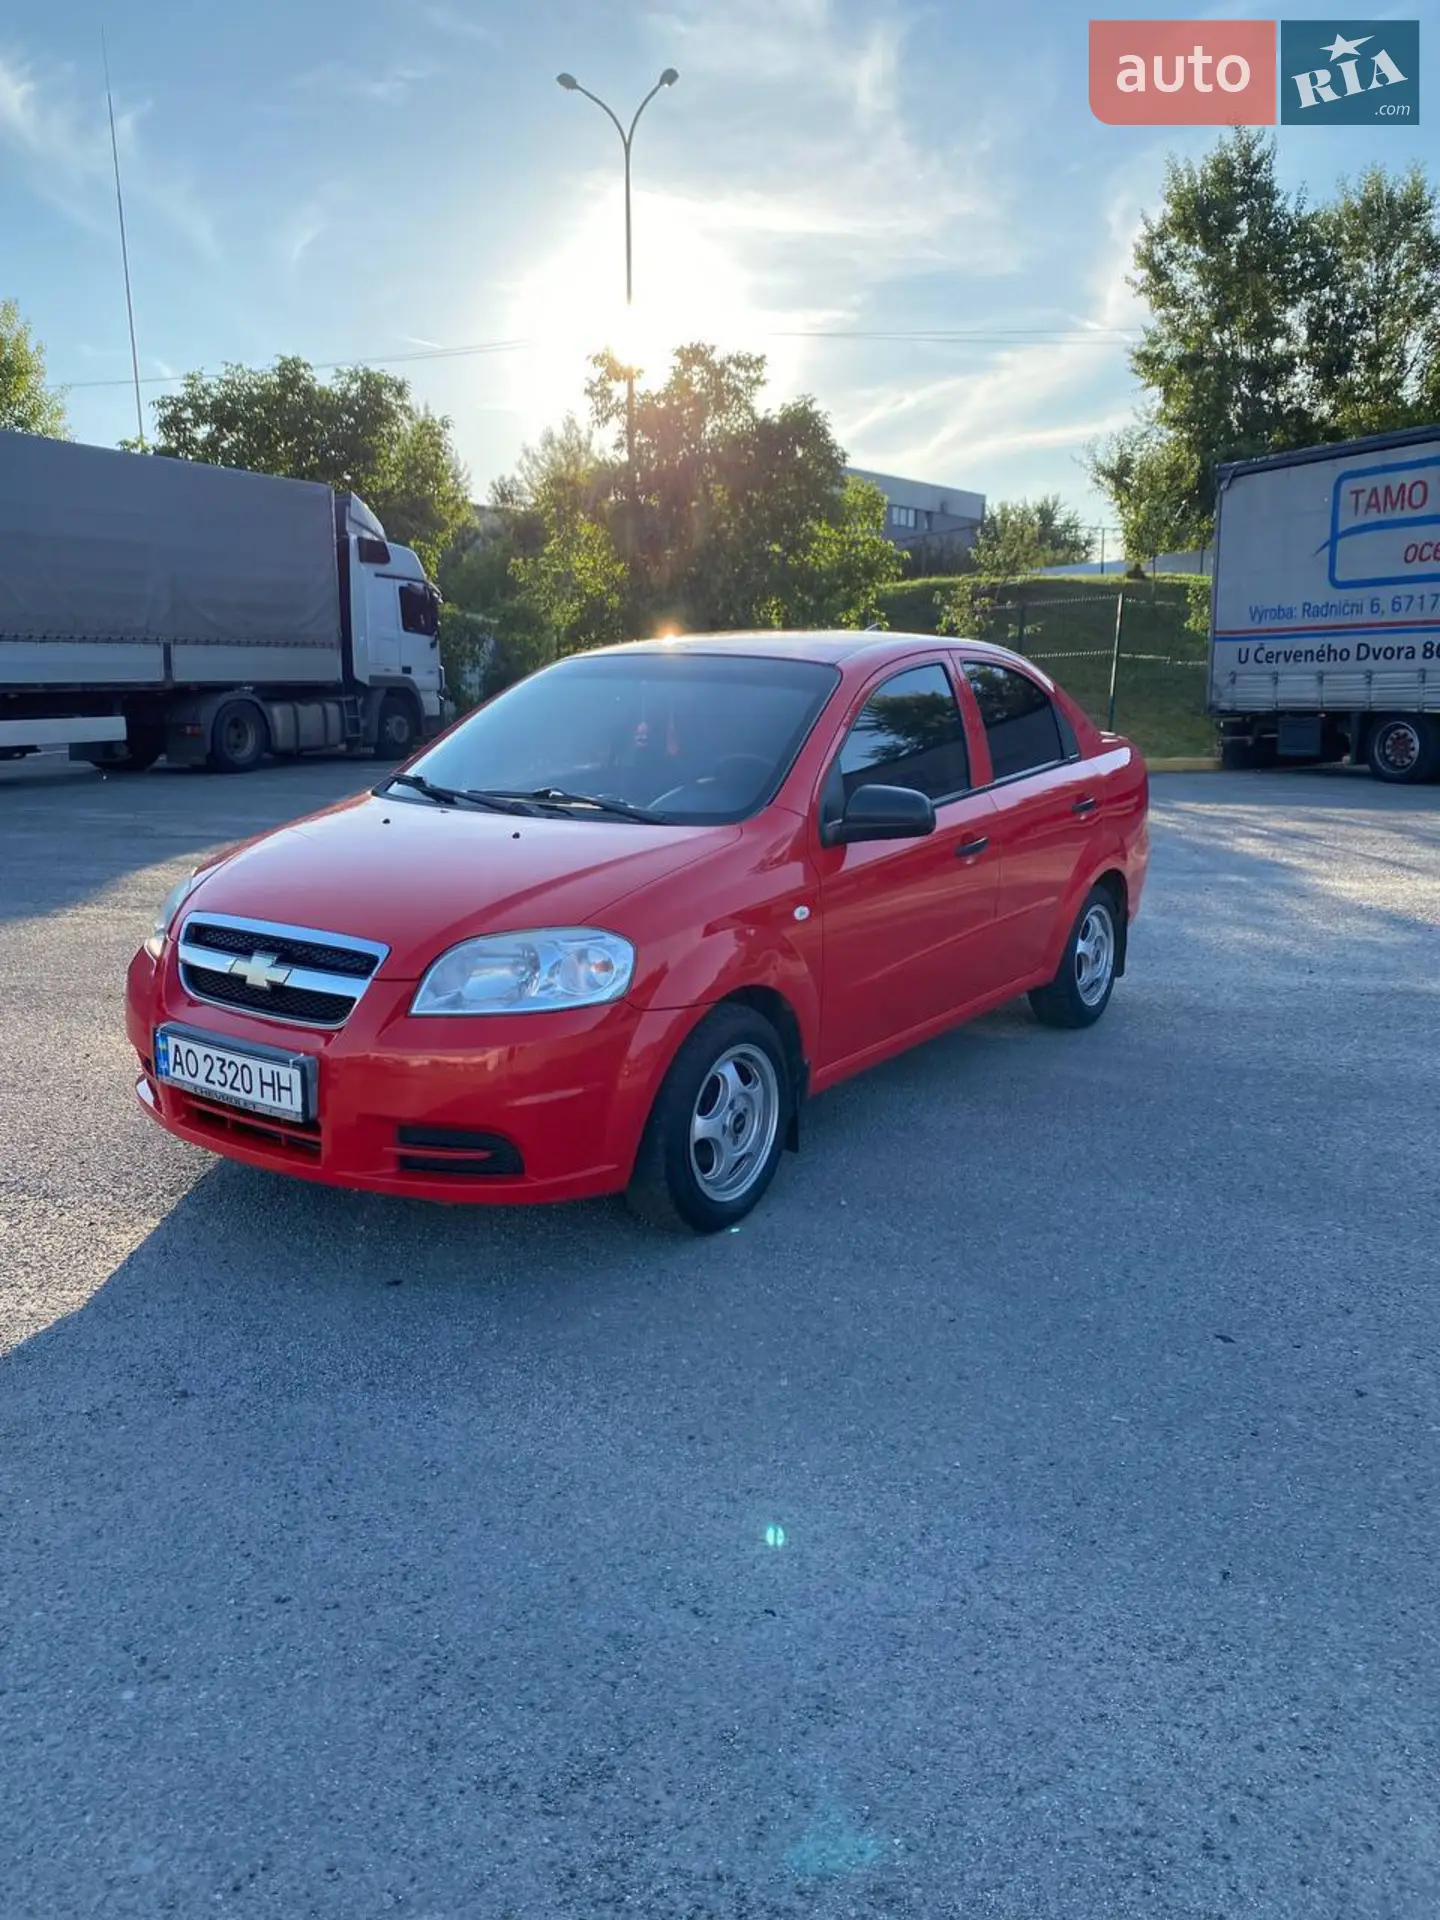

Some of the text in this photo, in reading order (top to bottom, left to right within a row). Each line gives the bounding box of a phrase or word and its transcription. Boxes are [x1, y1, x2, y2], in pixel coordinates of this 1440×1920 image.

[1350, 480, 1428, 517] TAMO
[1370, 597, 1385, 616] 6,
[1238, 647, 1249, 664] U
[1254, 642, 1350, 664] Červeného
[1356, 642, 1416, 661] Dvora
[172, 1043, 294, 1105] AO 2320 HH
